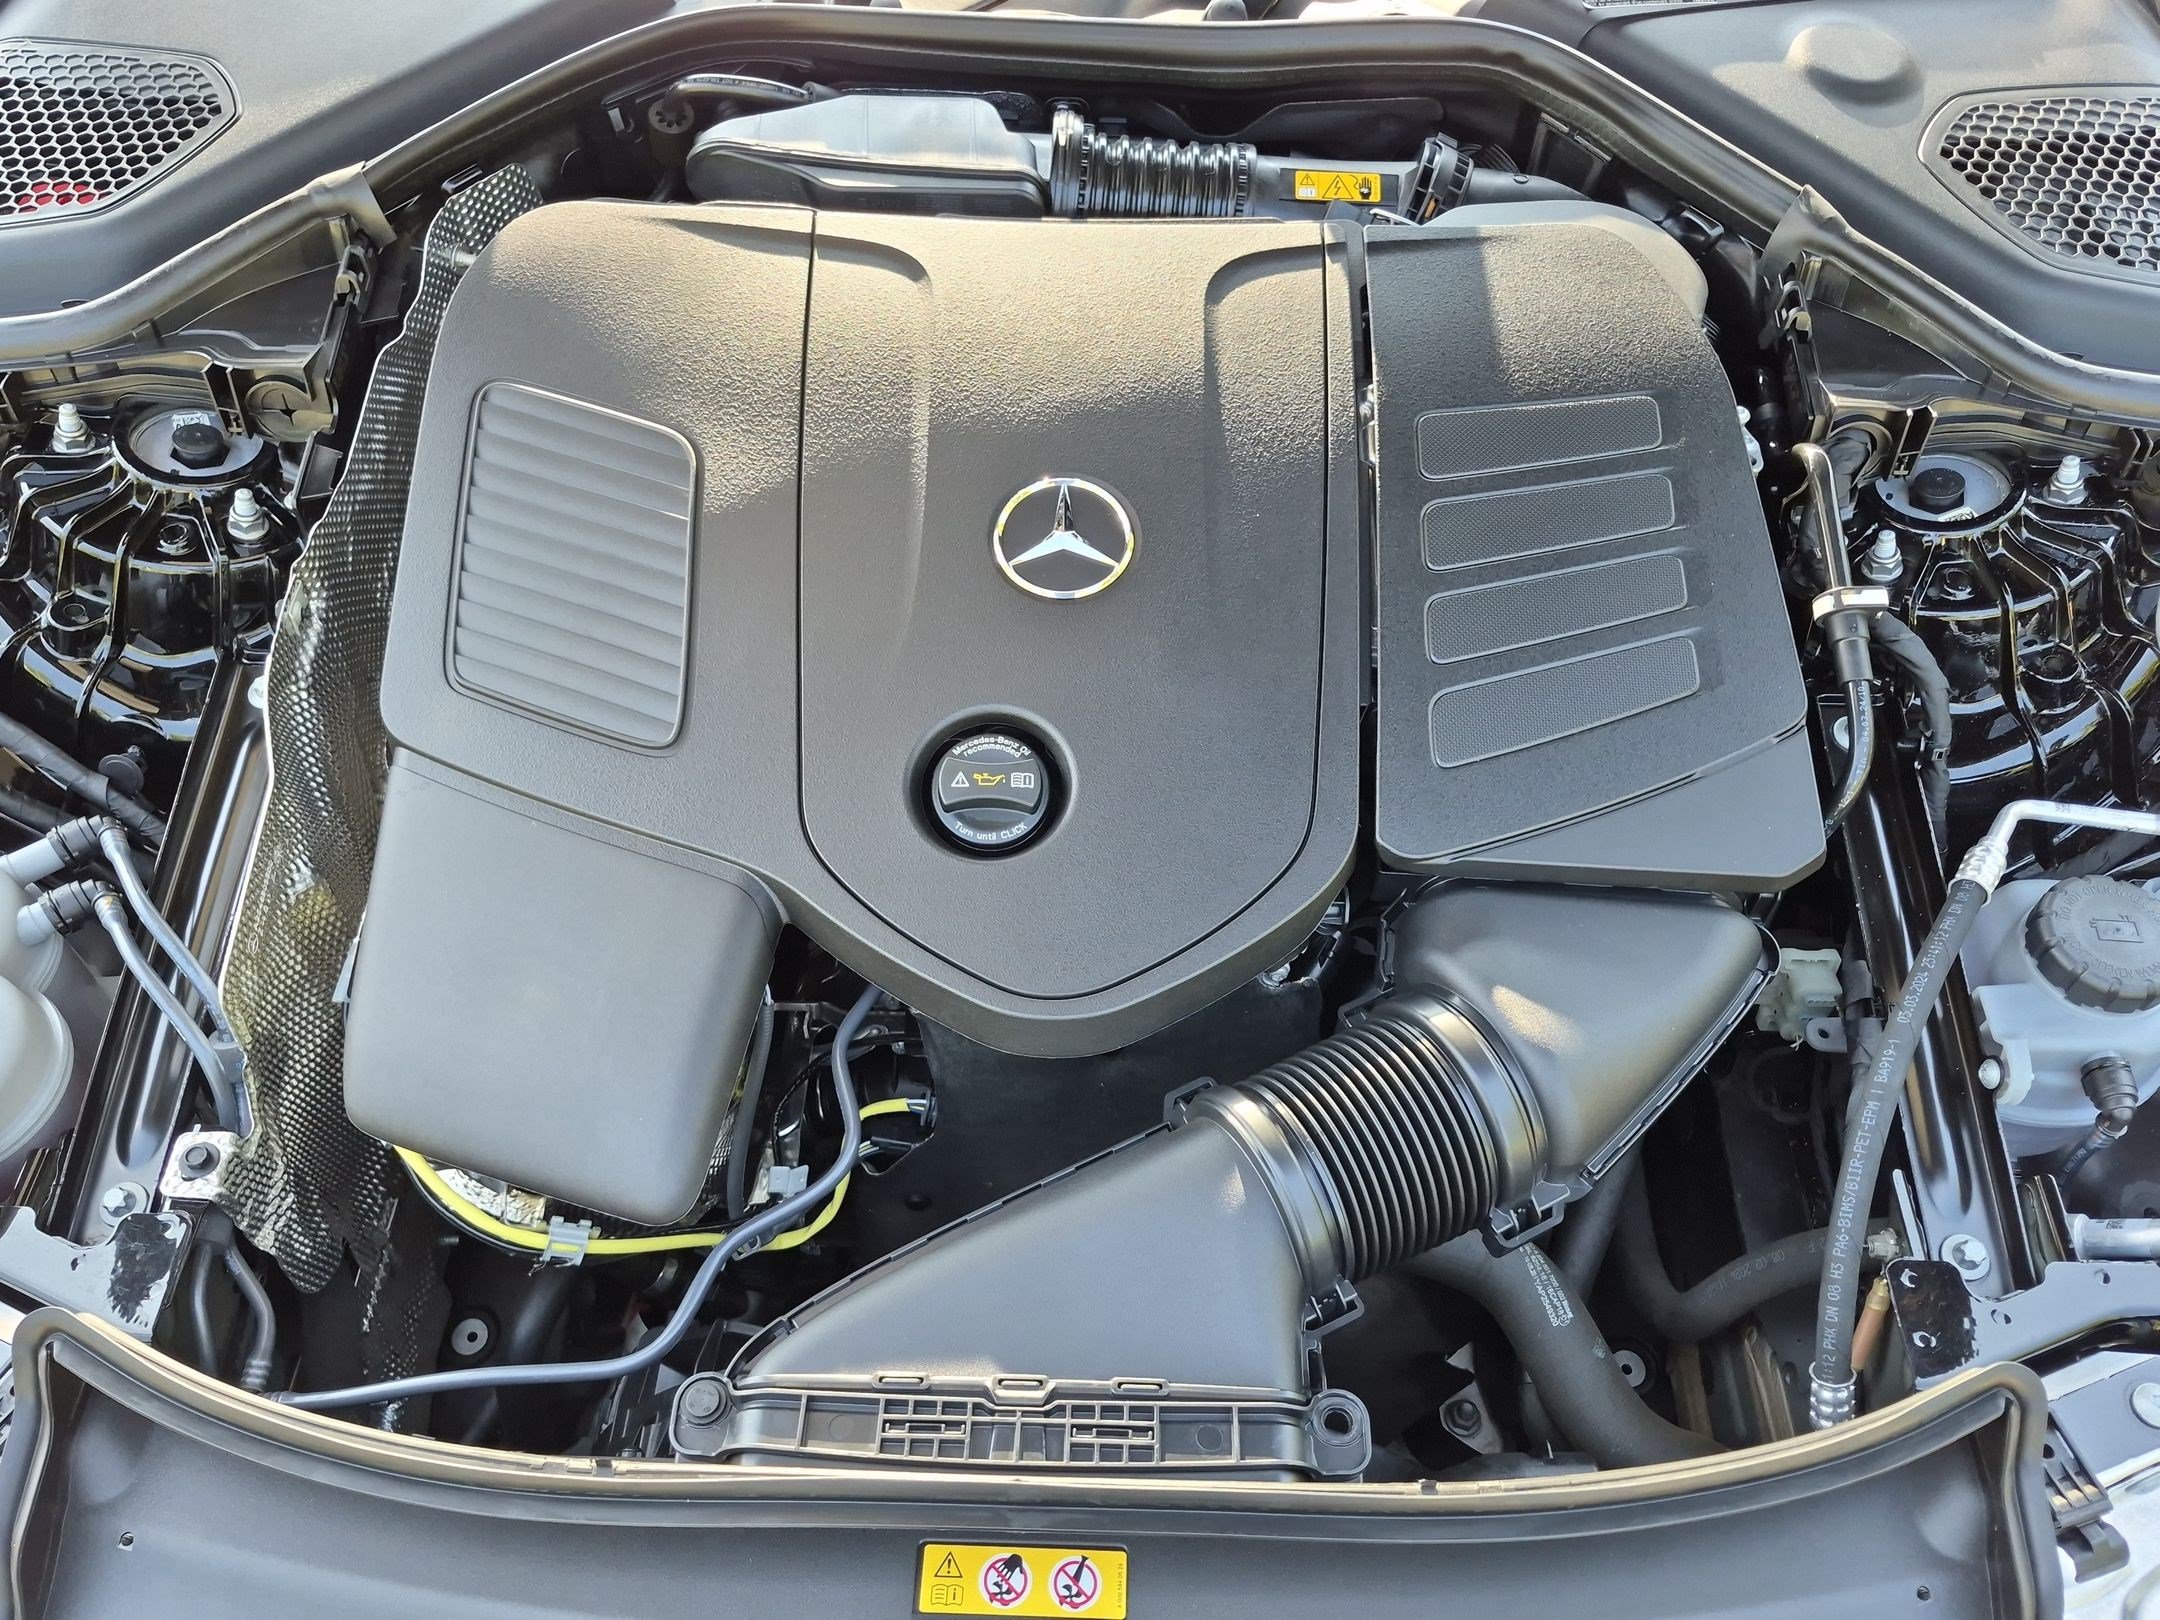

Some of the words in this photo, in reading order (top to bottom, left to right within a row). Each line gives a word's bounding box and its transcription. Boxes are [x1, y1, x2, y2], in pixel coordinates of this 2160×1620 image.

[952, 736, 1019, 755] Mercedes-Benz
[1020, 745, 1031, 755] Oil
[964, 744, 1022, 758] recommended
[954, 821, 973, 837] Turn
[977, 831, 996, 840] until
[1001, 822, 1028, 839] CLICK
[1874, 1039, 1902, 1083] BA919-1
[1831, 1261, 1845, 1279] H3
[1827, 1285, 1842, 1301] 08
[1824, 1306, 1839, 1329] DN
